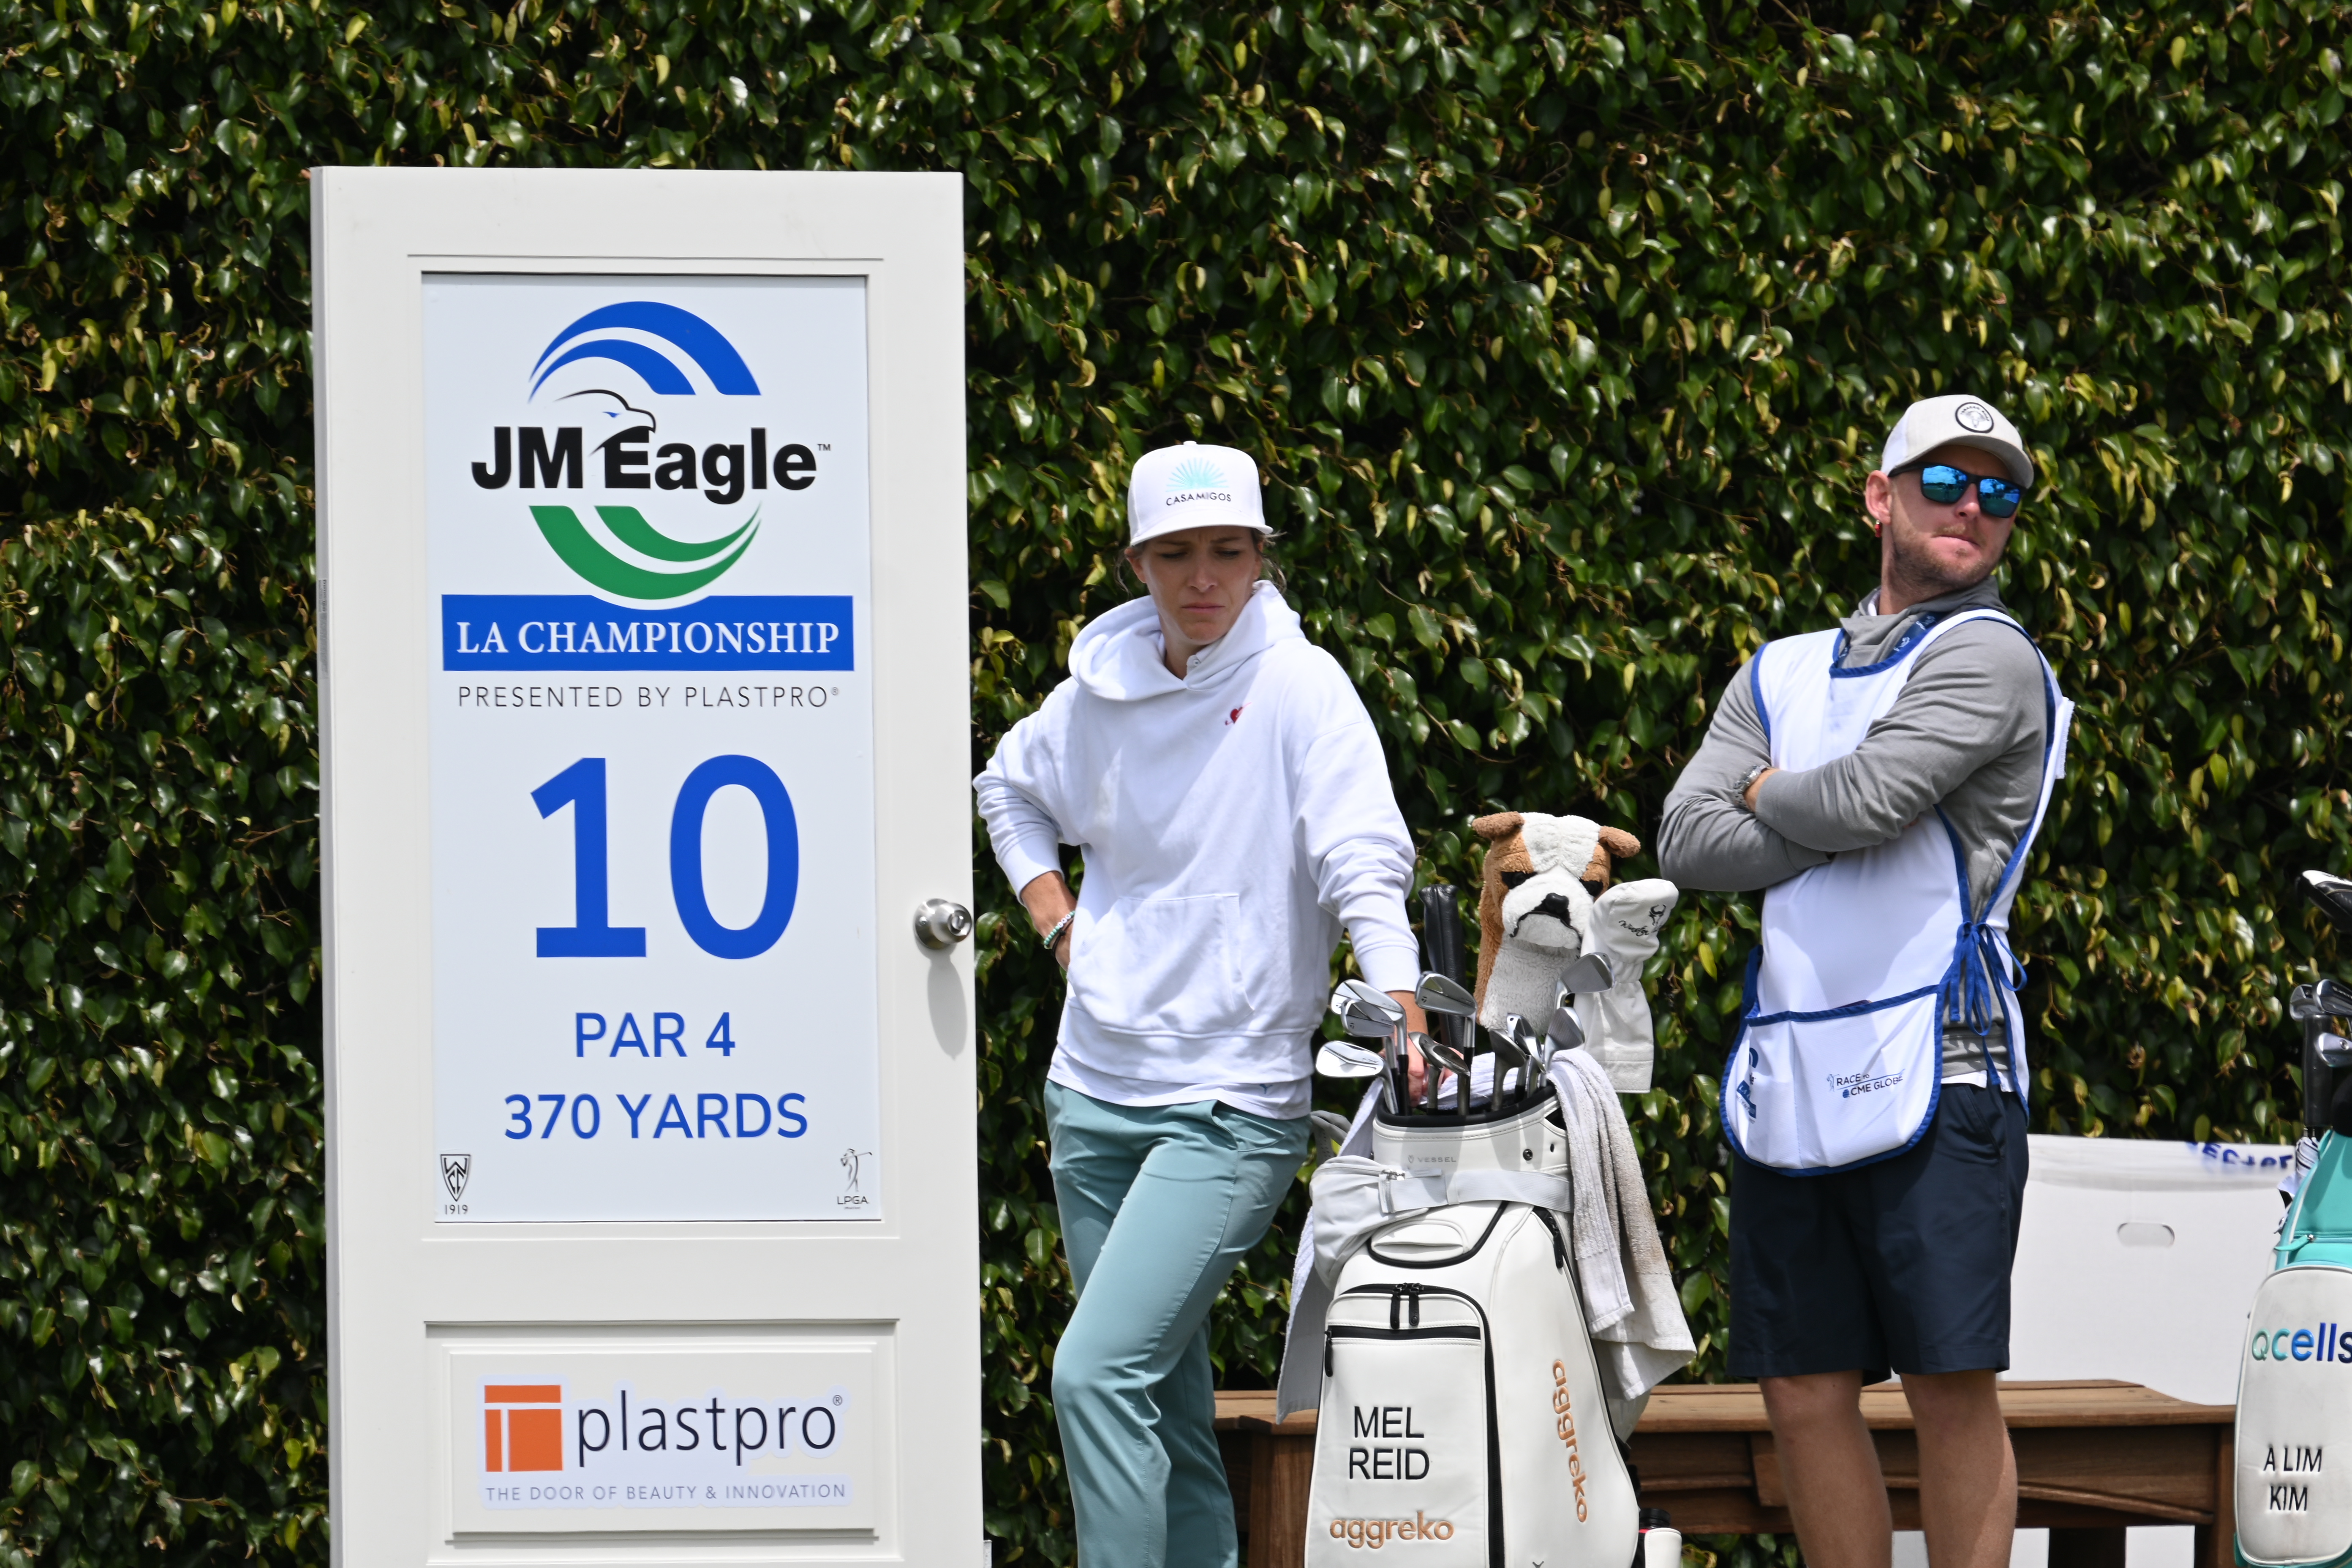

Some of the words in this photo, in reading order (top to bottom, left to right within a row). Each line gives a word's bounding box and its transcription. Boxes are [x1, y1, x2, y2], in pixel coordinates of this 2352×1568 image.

[471, 426, 583, 490] JM
[1166, 492, 1231, 506] CASAMIGOS
[456, 622, 509, 653] LA
[518, 621, 839, 653] CHAMPIONSHIP
[459, 686, 622, 708] PRESENTED
[639, 687, 670, 708] BY
[531, 754, 799, 960] 10
[576, 1012, 687, 1057] PAR
[706, 1012, 735, 1056] 4
[1837, 1073, 1861, 1086] RACE
[1851, 1083, 1871, 1095] CME
[1874, 1076, 1903, 1090] GLOBE
[505, 1094, 600, 1140] 370
[616, 1093, 807, 1138] YARDS
[445, 1204, 468, 1215] 1919
[837, 1195, 869, 1205] LPGA
[1354, 1406, 1425, 1438] MEL
[1552, 1359, 1588, 1523] aggreko
[1349, 1447, 1429, 1480] REID
[2263, 1446, 2276, 1471] A
[2284, 1446, 2322, 1472] LIM
[485, 1487, 520, 1501] THE
[530, 1486, 584, 1500] DOOR
[593, 1486, 617, 1500] OF
[626, 1486, 697, 1500] BEAUTY
[705, 1486, 717, 1499] &
[726, 1484, 845, 1499] INNOVATION
[2270, 1485, 2308, 1511] KIM
[1329, 1510, 1454, 1549] aggreko
